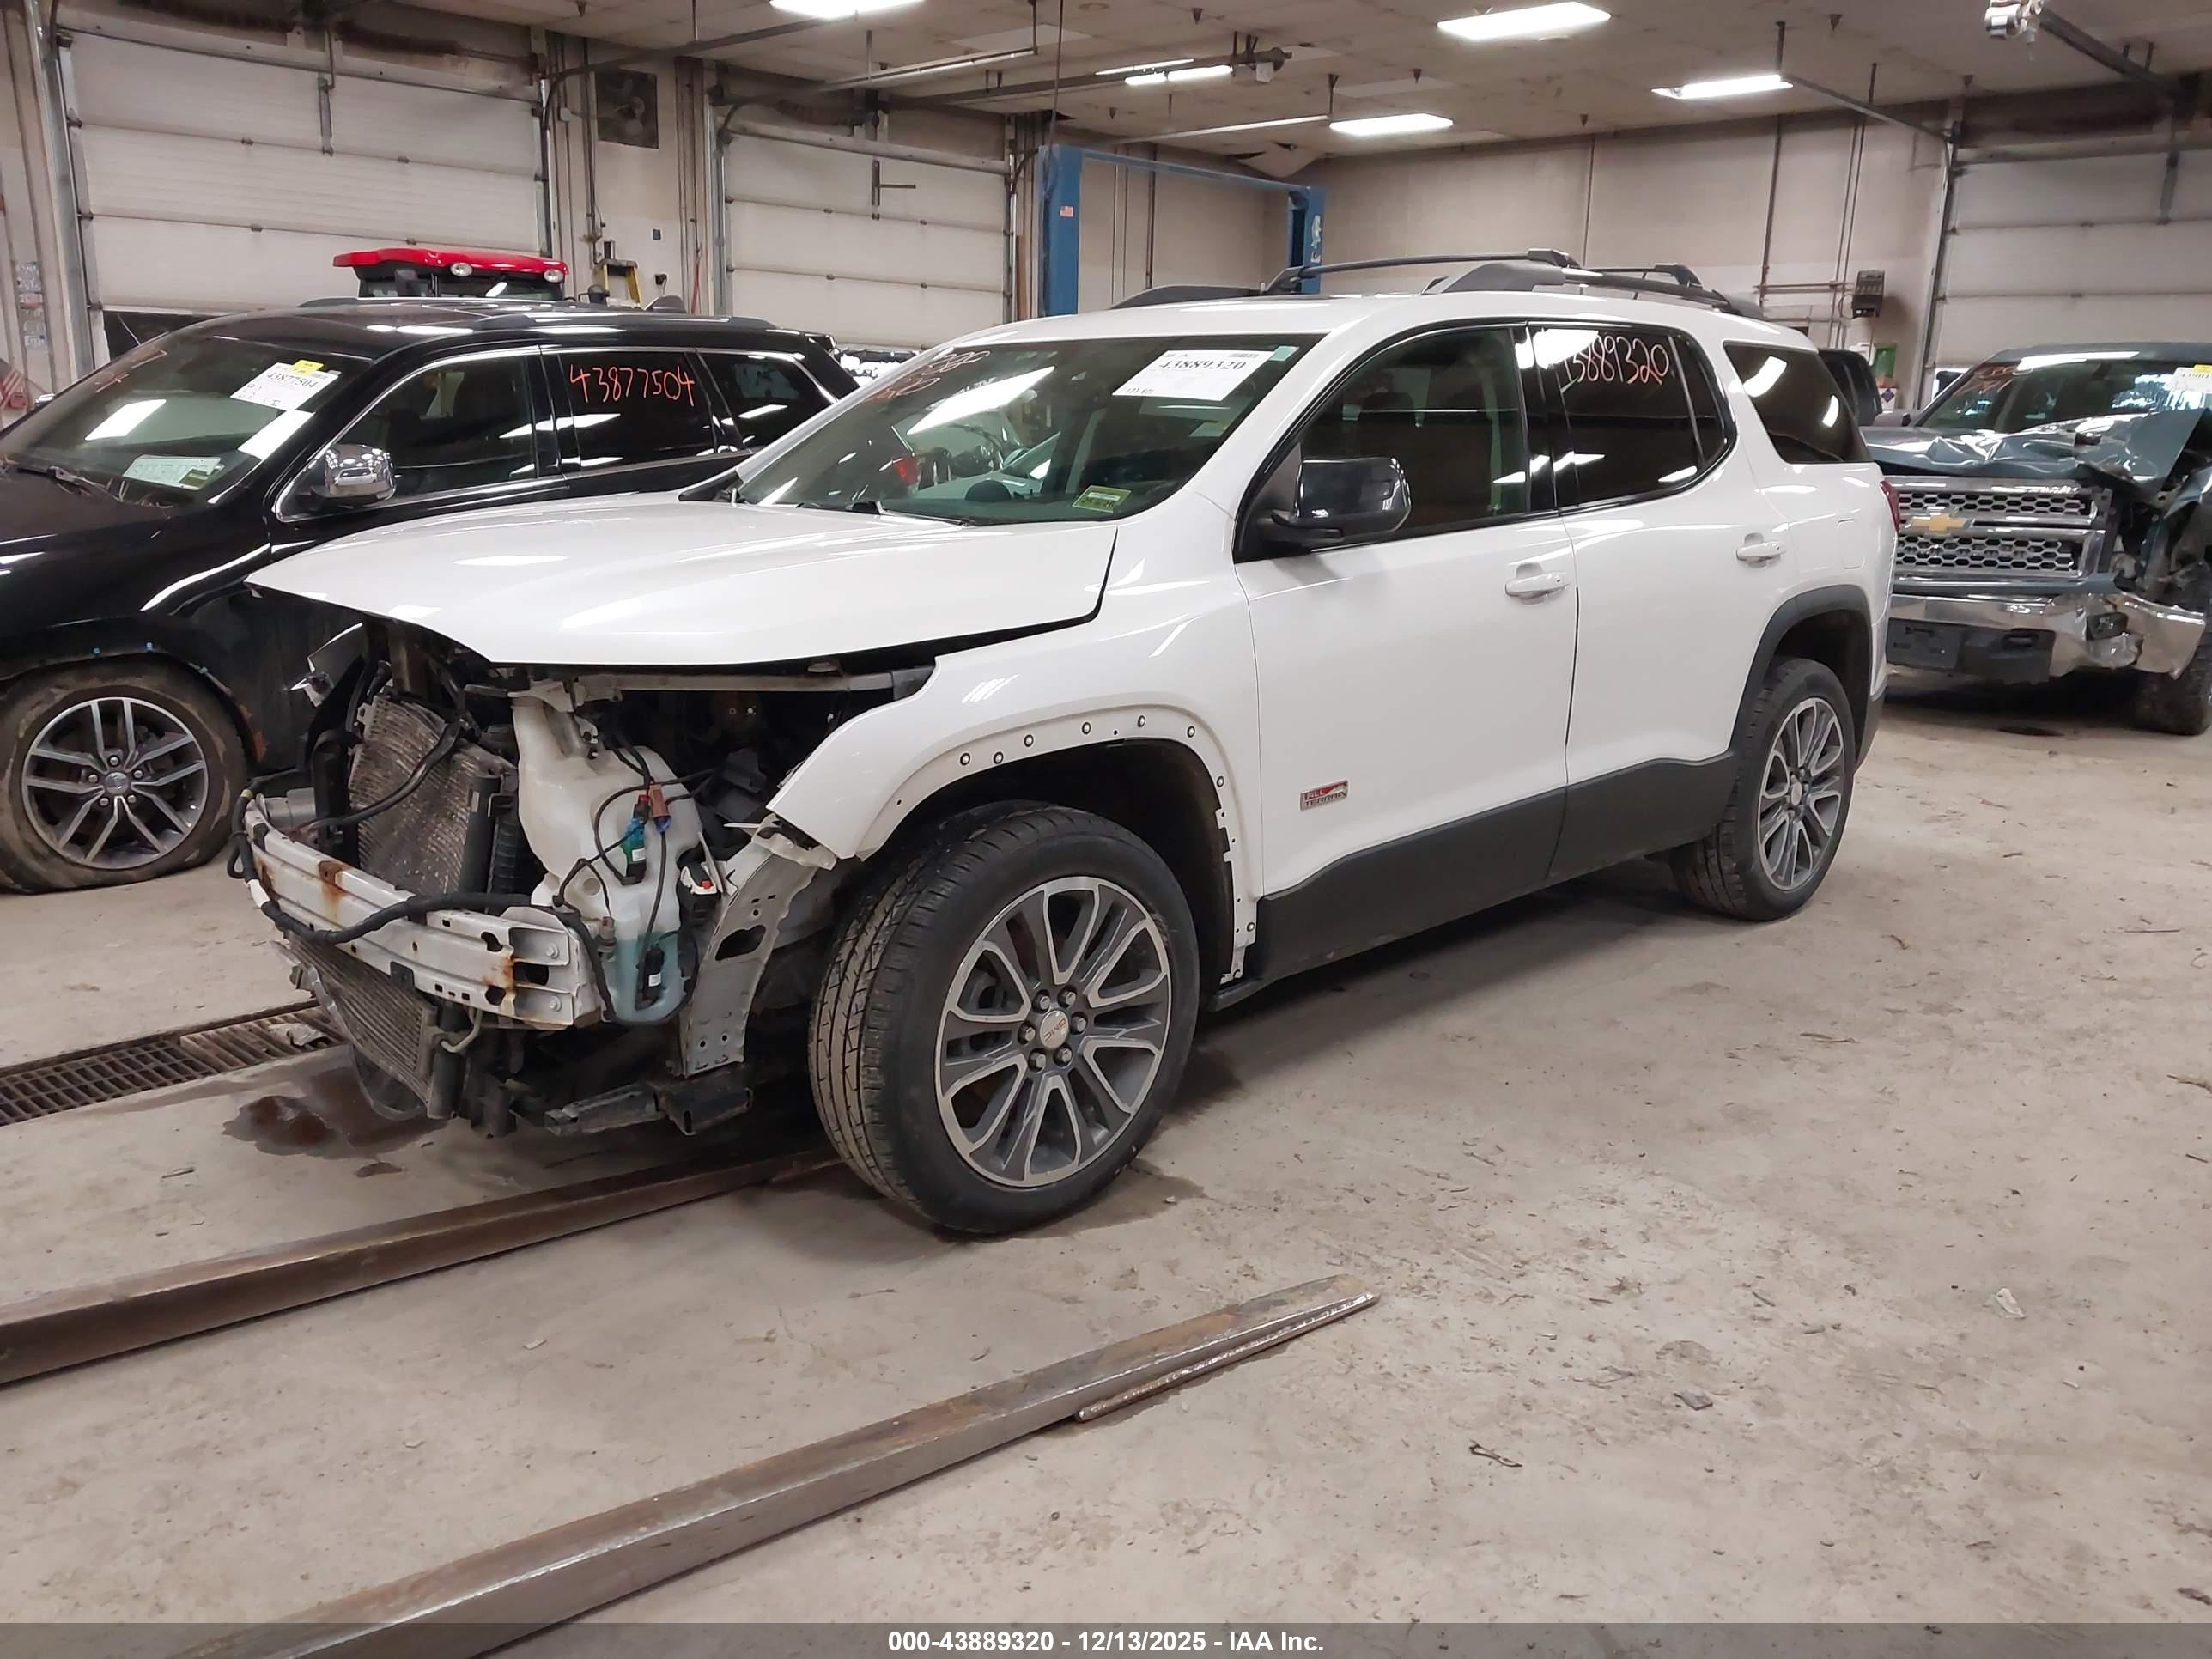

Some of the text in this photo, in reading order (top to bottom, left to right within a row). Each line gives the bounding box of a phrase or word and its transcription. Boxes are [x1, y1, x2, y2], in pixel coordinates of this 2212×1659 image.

[1158, 360, 1248, 370] 43889320
[570, 363, 696, 407] 43877504
[1043, 1018, 1066, 1042] GMC
